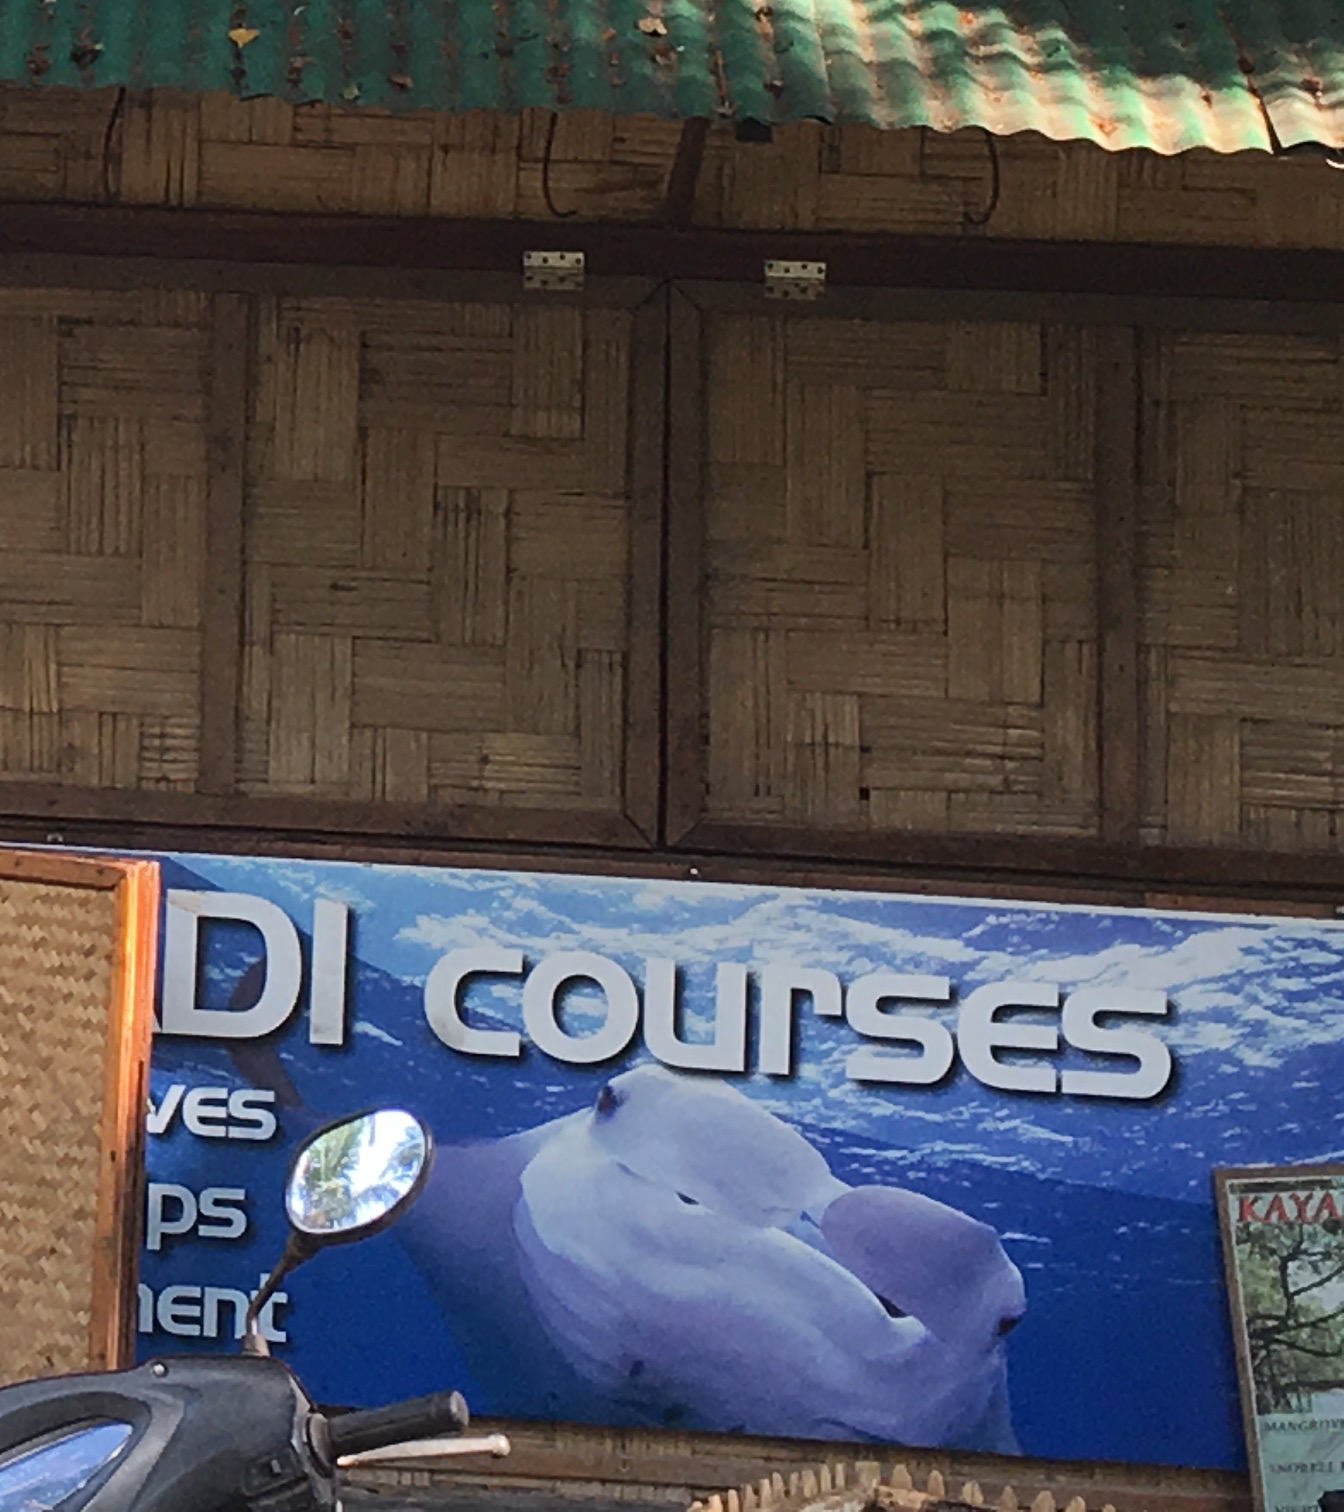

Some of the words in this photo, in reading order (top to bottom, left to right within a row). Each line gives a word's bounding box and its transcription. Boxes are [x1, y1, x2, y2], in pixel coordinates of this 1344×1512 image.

[149, 888, 349, 1045] DI
[425, 946, 1173, 1100] courses
[145, 1083, 278, 1142] ves
[146, 1181, 248, 1252] ps
